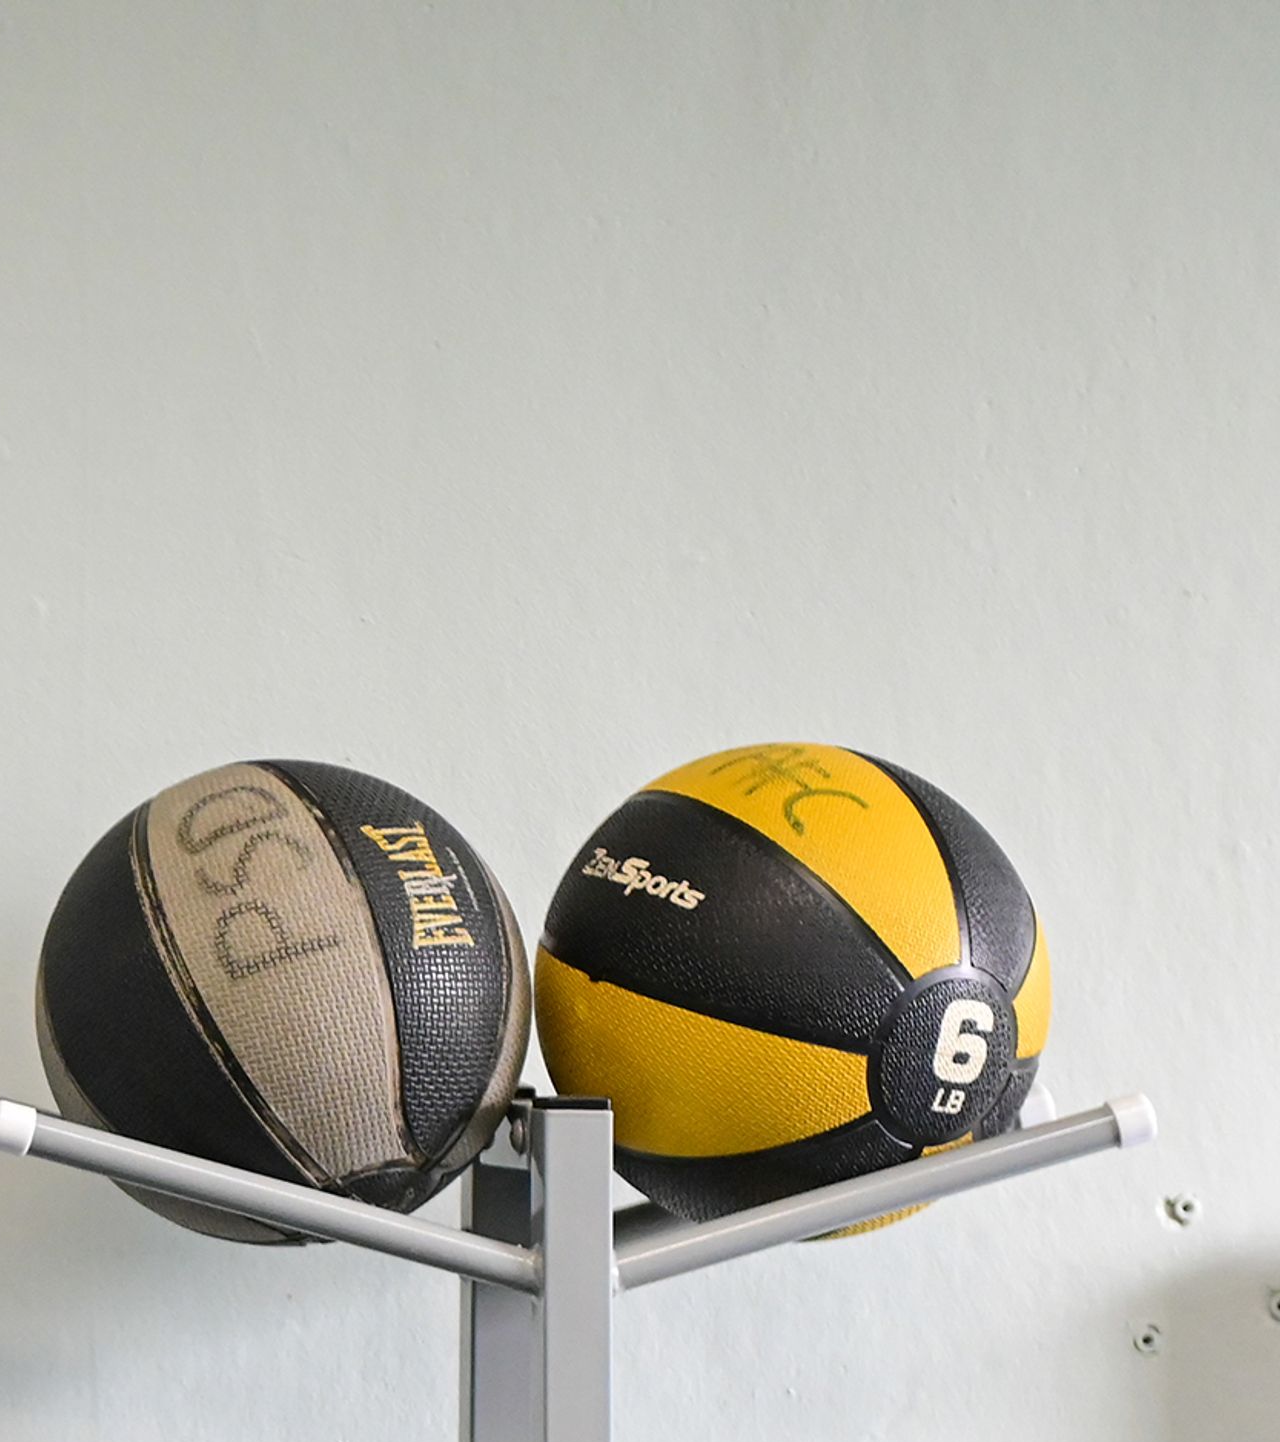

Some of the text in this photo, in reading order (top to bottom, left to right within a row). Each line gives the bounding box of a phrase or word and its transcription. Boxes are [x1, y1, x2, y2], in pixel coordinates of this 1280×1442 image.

[359, 820, 475, 950] EVERLAST
[932, 999, 994, 1084] 6
[931, 1087, 966, 1115] LB
